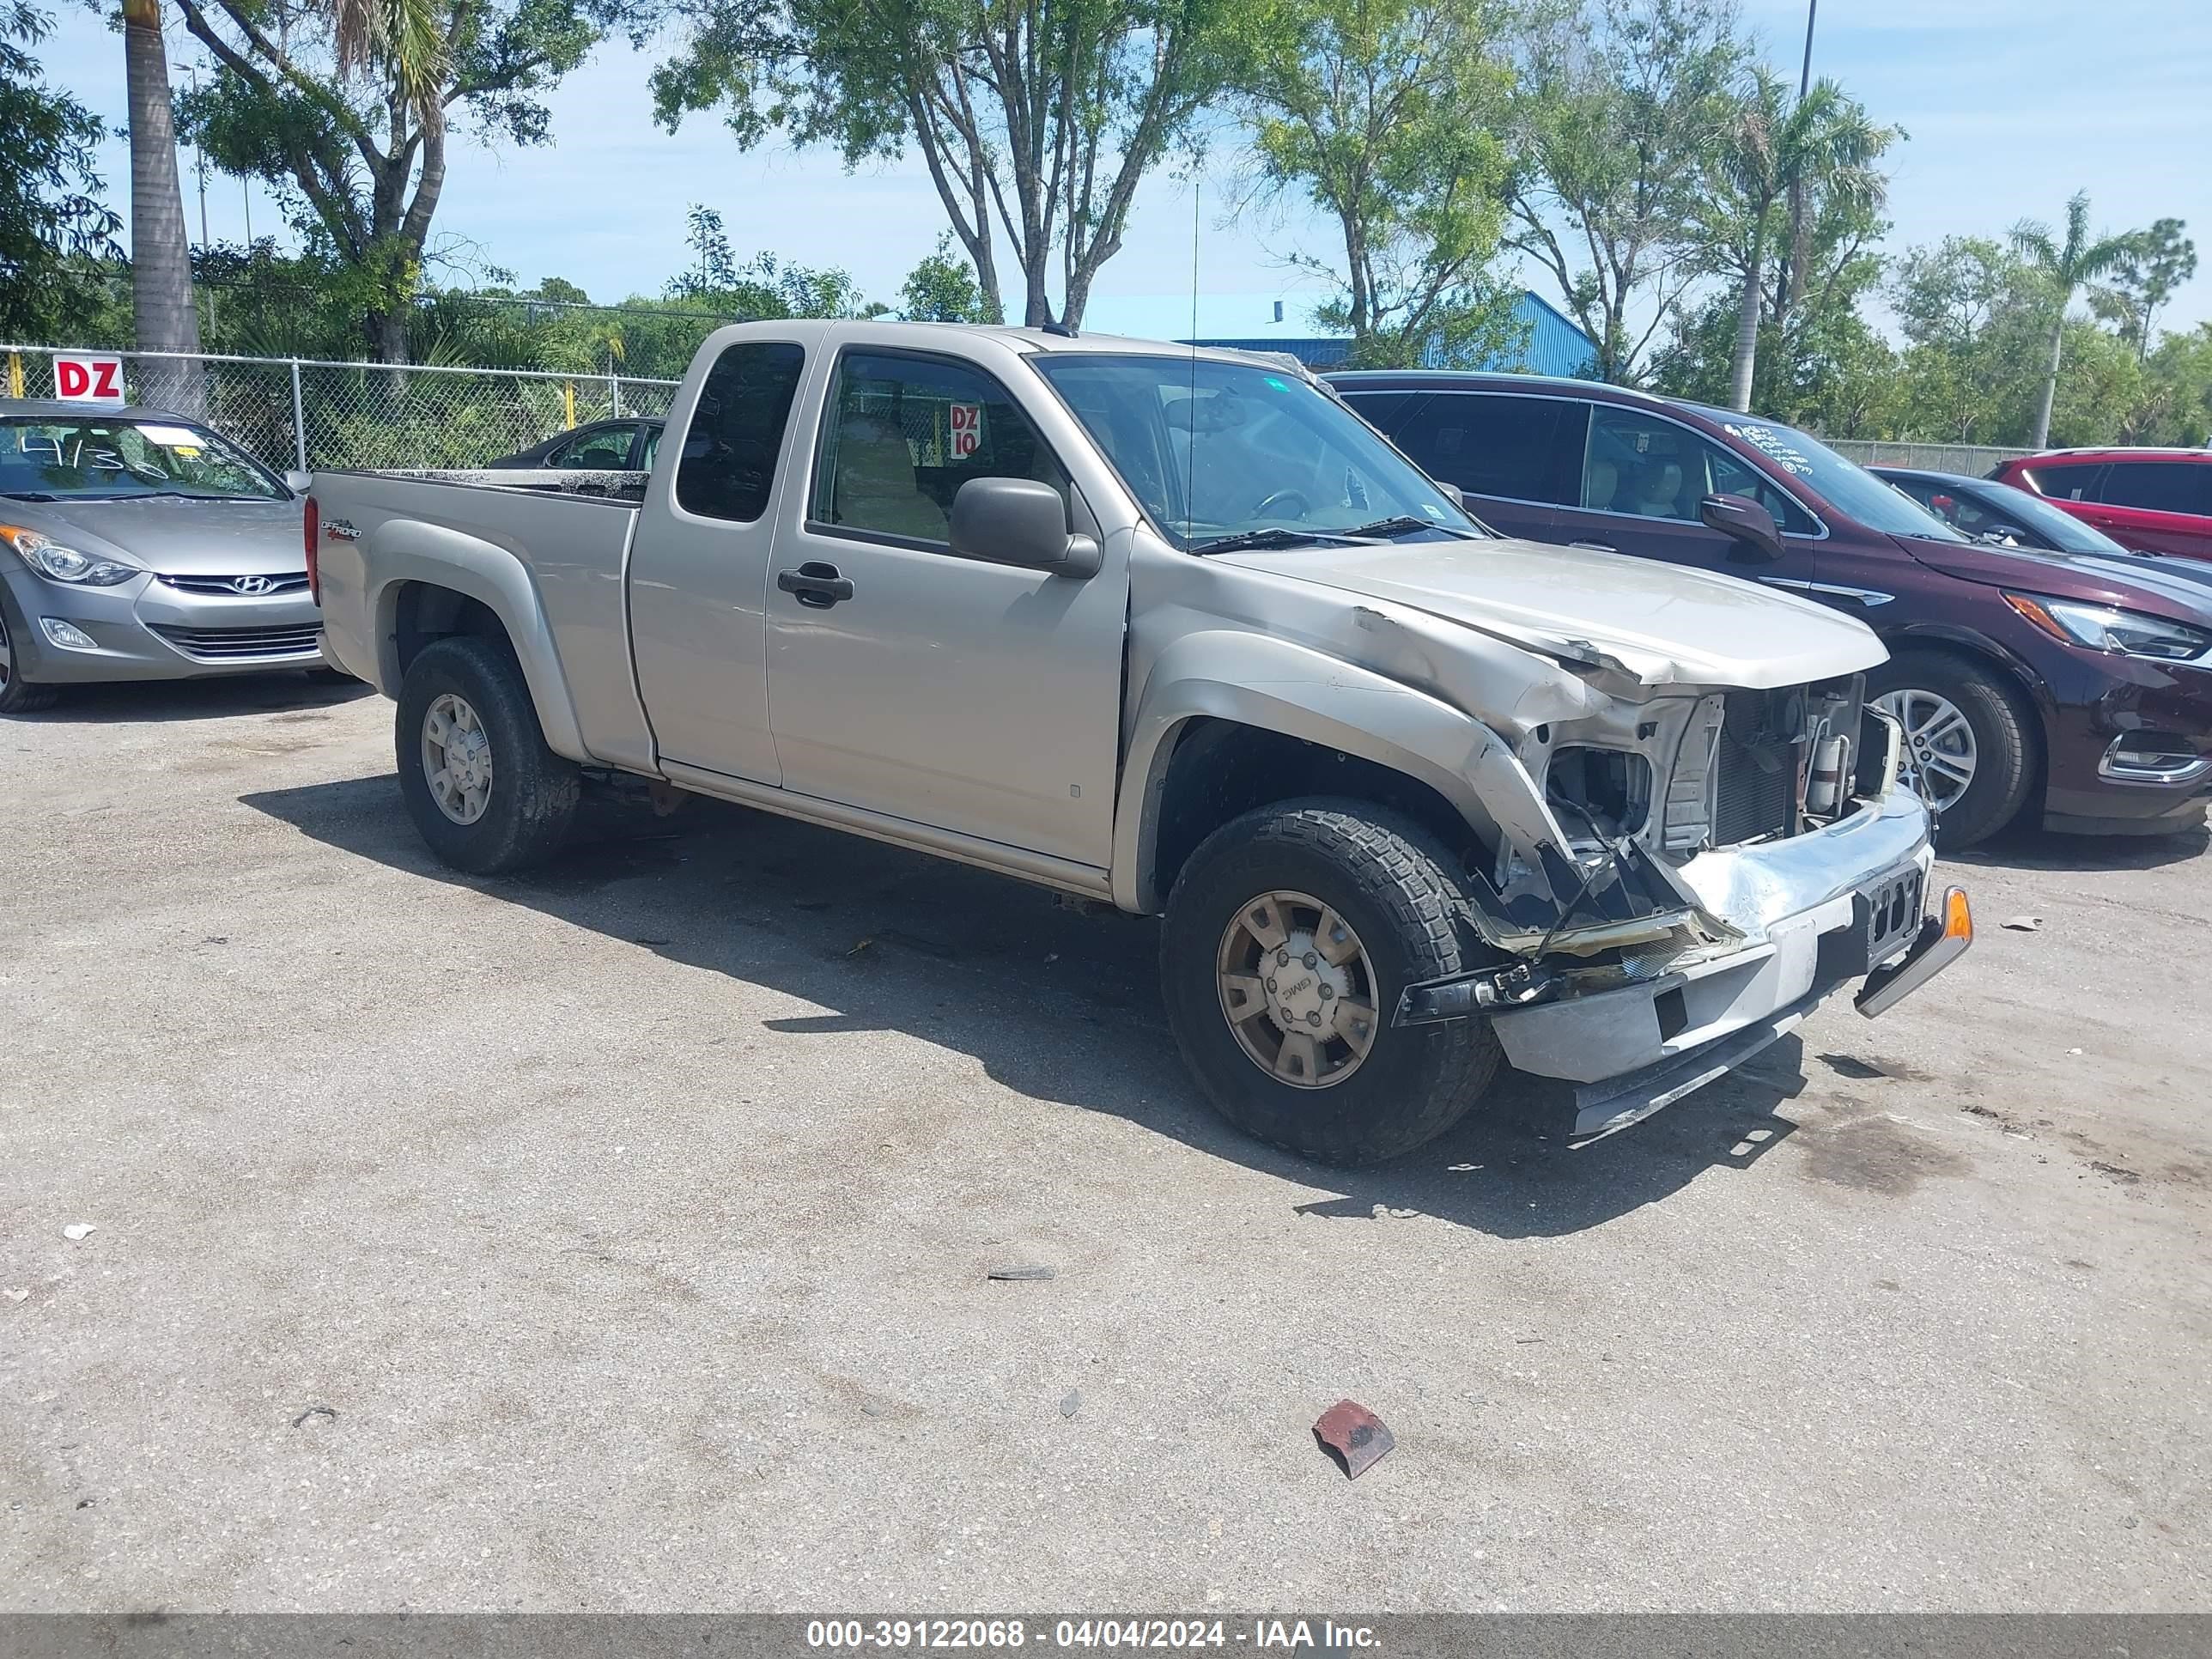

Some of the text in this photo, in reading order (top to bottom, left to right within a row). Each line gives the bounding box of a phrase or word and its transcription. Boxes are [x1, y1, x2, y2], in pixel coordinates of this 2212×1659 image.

[58, 362, 119, 397] DZ
[952, 406, 978, 429] DZ
[1282, 977, 1312, 1001] GMC
